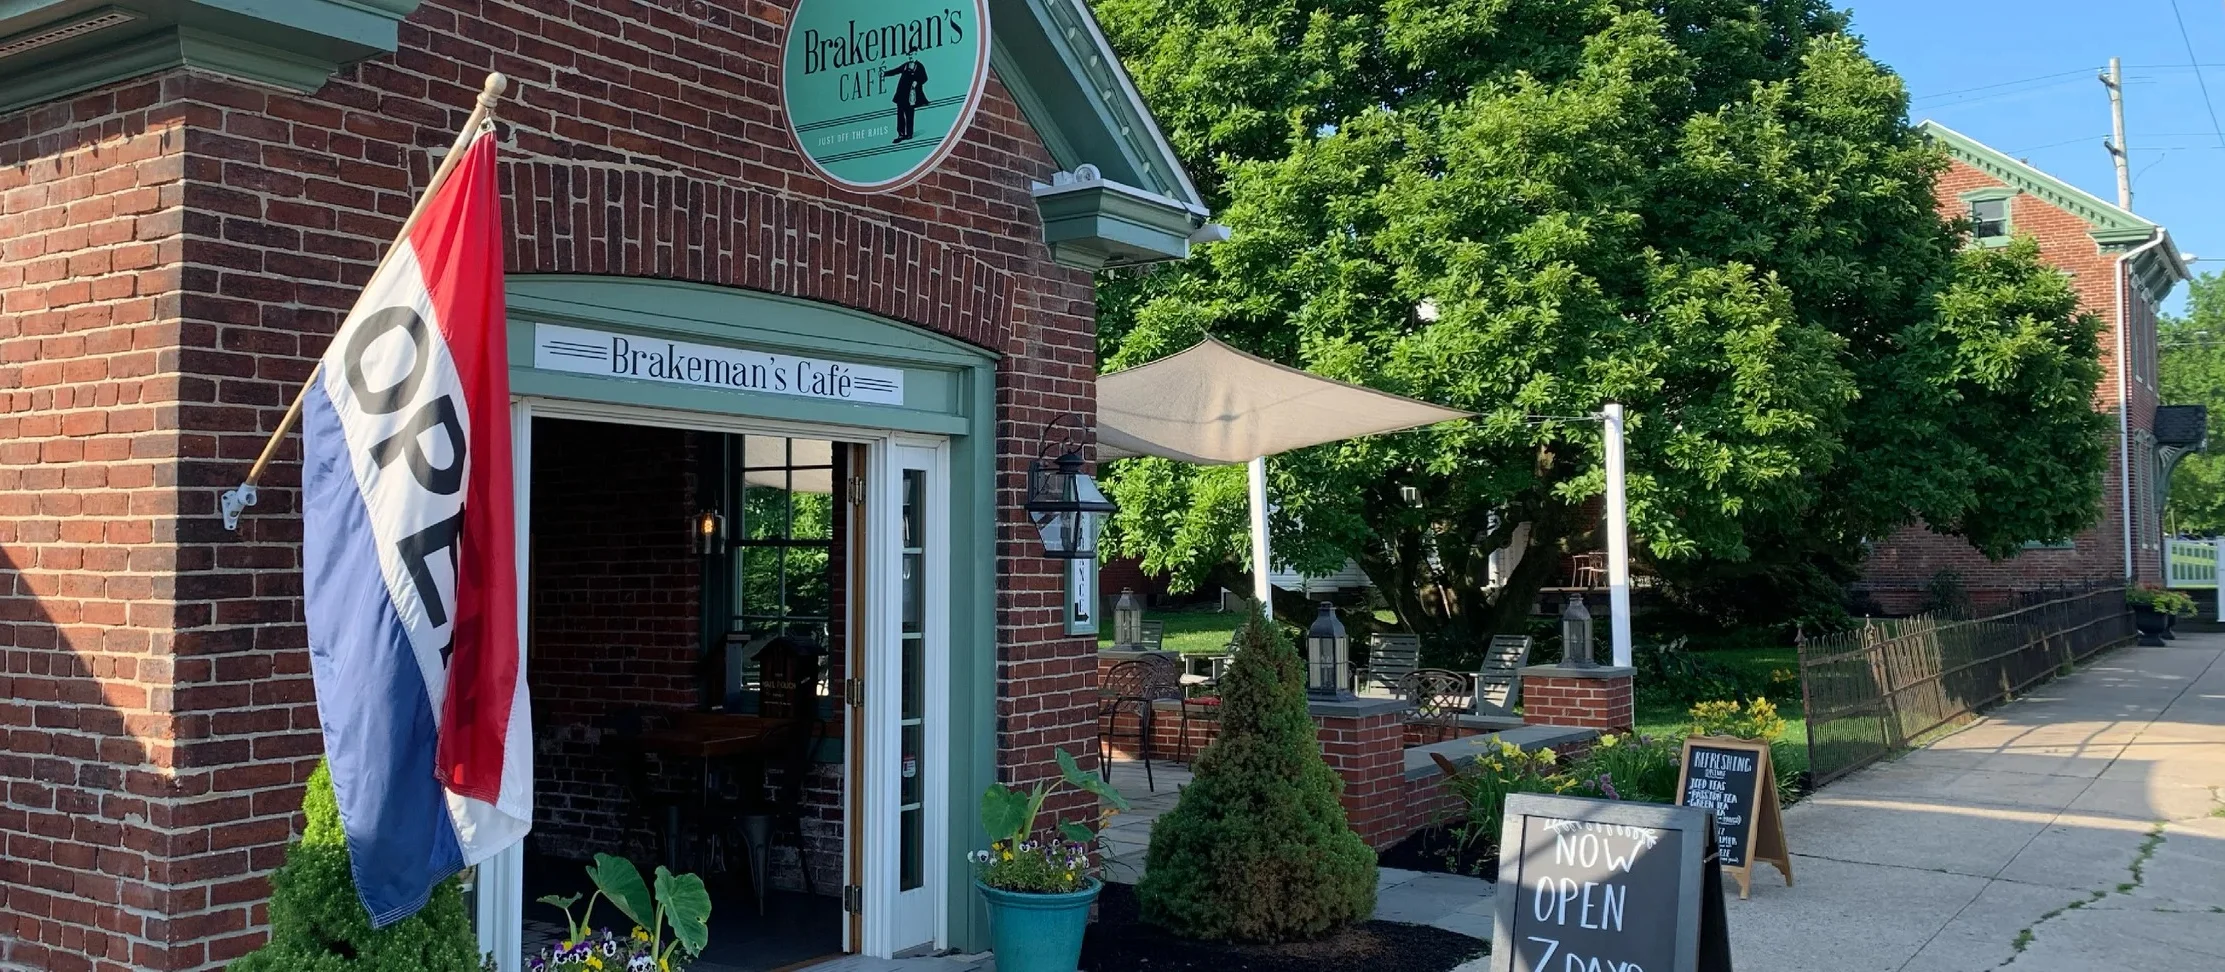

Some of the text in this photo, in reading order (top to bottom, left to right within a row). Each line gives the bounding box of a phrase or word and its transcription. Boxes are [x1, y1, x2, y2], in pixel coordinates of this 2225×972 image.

[804, 8, 963, 75] Brakeman's
[839, 61, 887, 102] CAFÉ
[818, 125, 889, 147] JUST OFF THE RAILS
[611, 336, 851, 399] Brakeman's Café
[344, 305, 467, 671] OPE
[1694, 751, 1752, 772] REFRESHING
[1689, 777, 1727, 791] ICED TEAS
[1723, 793, 1738, 803] TEA
[1556, 834, 1643, 873] NOW
[1534, 876, 1626, 932] OPEN
[1527, 936, 1559, 972] 7
